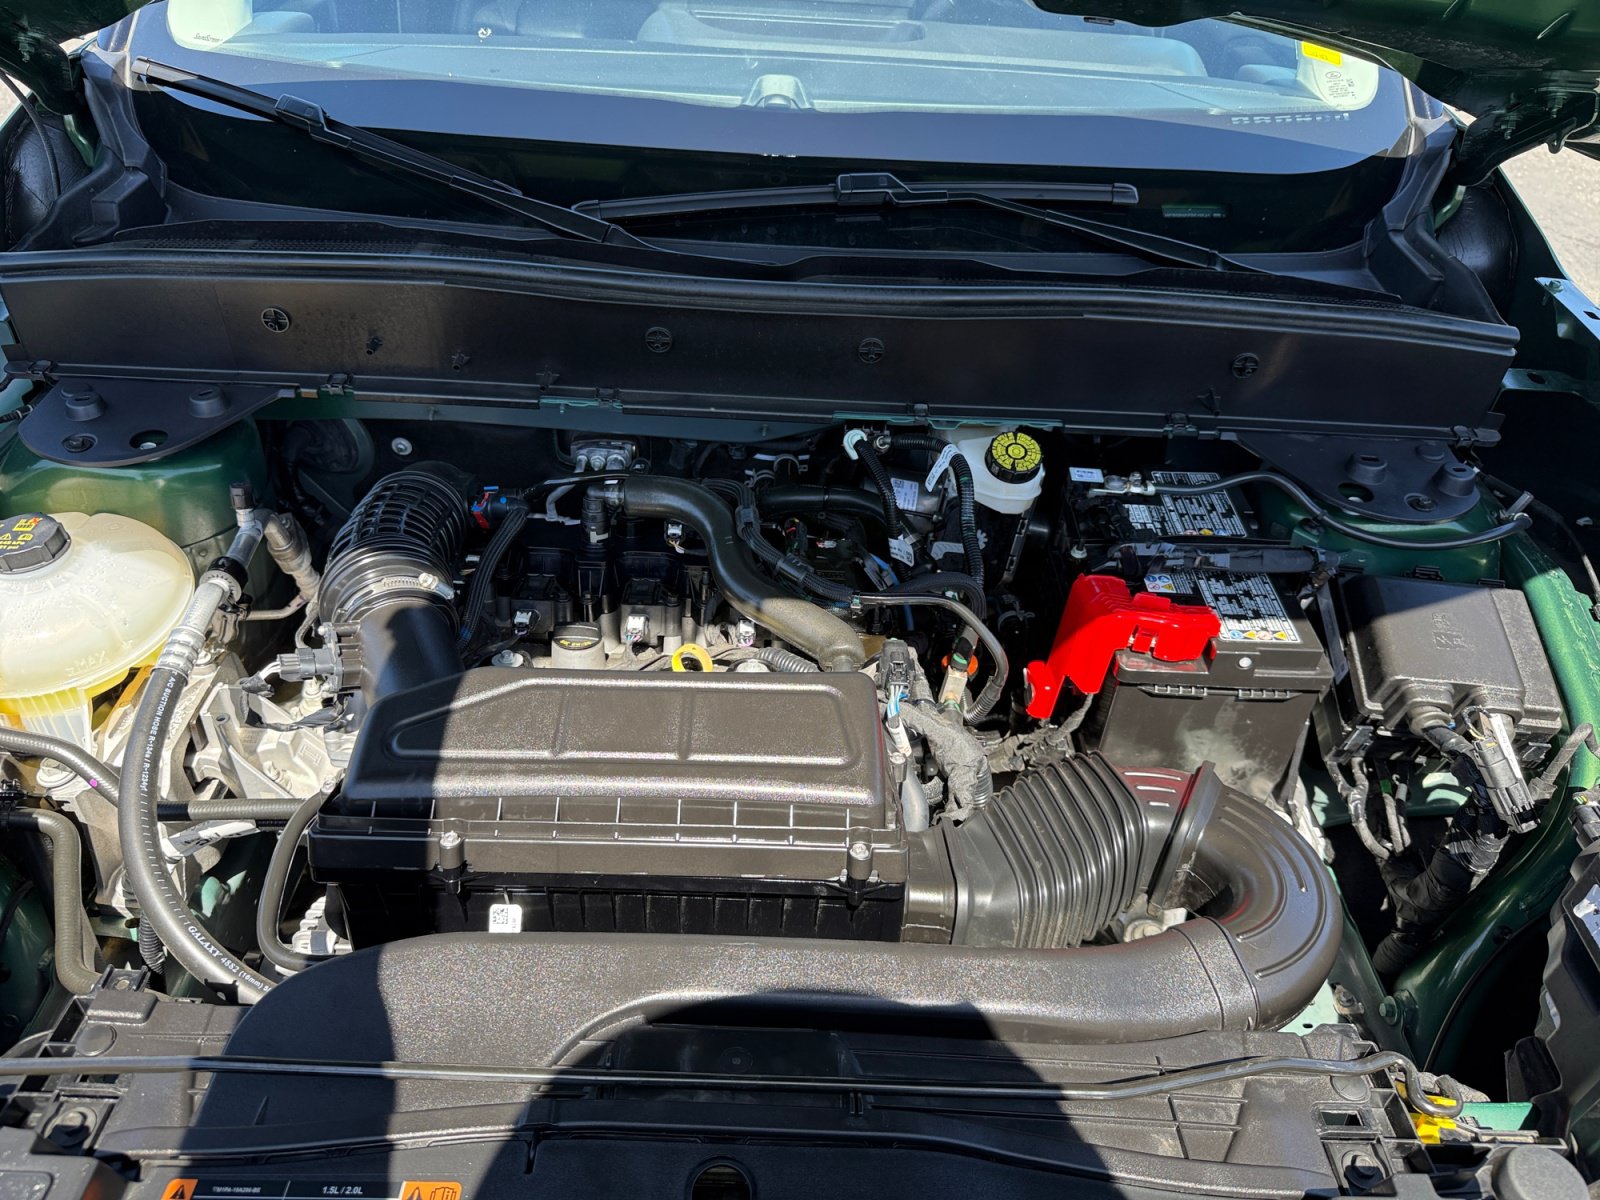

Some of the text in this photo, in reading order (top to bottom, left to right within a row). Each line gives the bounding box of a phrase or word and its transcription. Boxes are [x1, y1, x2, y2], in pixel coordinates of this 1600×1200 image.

[166, 676, 176, 688] A/C
[156, 688, 172, 716] SUCTION
[150, 715, 162, 736] HOSE
[143, 735, 156, 759] R-134a
[140, 763, 151, 792] R-1234yf
[188, 925, 223, 958] GALAXY
[322, 1186, 339, 1194] 1.5L
[345, 1186, 363, 1194] 2.0L
